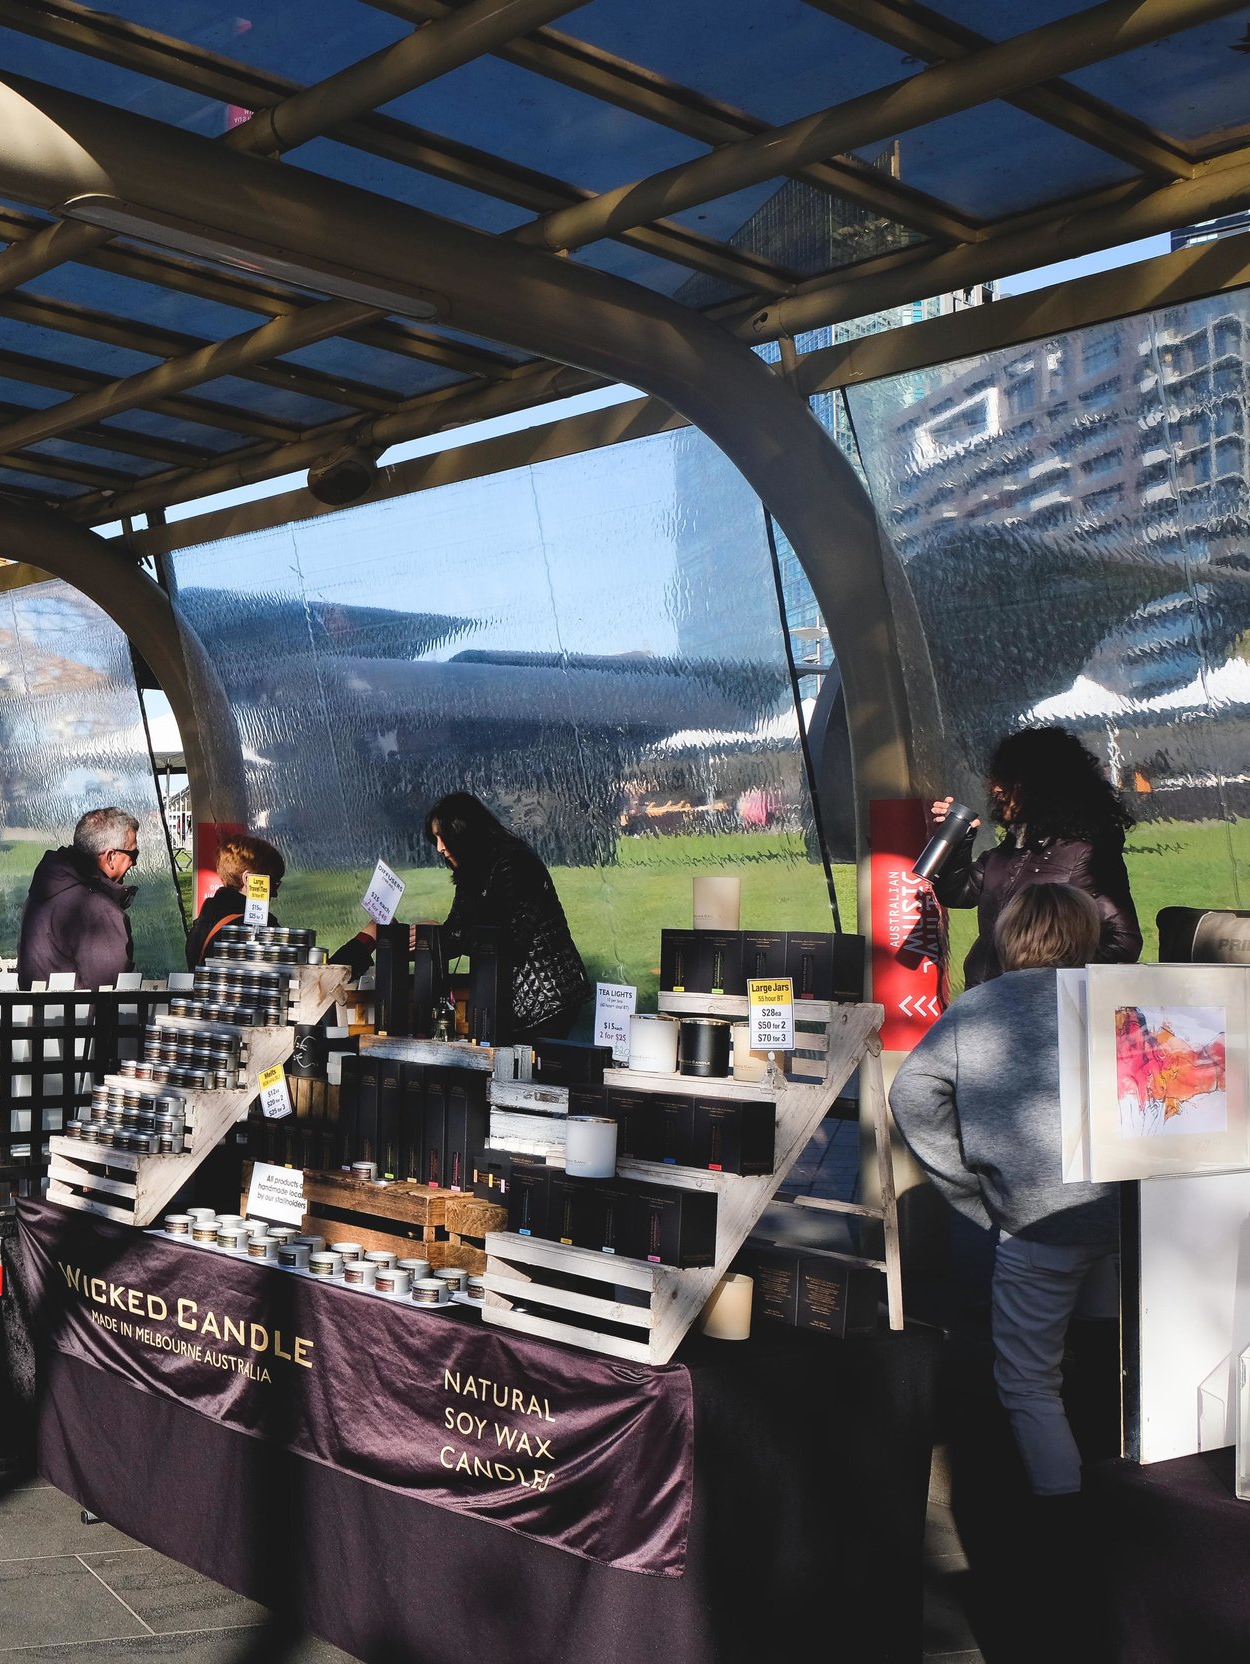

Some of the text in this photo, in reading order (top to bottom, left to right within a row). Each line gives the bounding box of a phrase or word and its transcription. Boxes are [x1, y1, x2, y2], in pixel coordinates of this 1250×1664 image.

[378, 865, 404, 892] DIFFUSERS
[380, 901, 390, 914] each
[888, 871, 900, 948] AUSTRALIAN
[599, 988, 633, 999] TEA LIGHTS
[751, 983, 790, 994] Large Jars
[776, 994, 784, 1002] BT
[758, 1021, 771, 1030] $50
[781, 1021, 786, 1029] 2
[604, 1032, 614, 1040] for
[615, 1033, 627, 1041] $25
[758, 1033, 771, 1042] $70
[781, 1033, 786, 1042] 3
[264, 1069, 277, 1079] Melts
[267, 1098, 275, 1108] $20
[268, 1108, 278, 1117] $25
[274, 1177, 298, 1189] products
[257, 1182, 288, 1195] handmade
[289, 1189, 303, 1199] loca
[257, 1187, 306, 1210] by our stallholders
[58, 1261, 314, 1368] WICKED CANDLE
[91, 1309, 272, 1384] MADE IN MELBOURNE AUSTRALIA
[444, 1368, 555, 1423] NATURAL
[444, 1407, 555, 1460] SOY WAX
[440, 1445, 555, 1492] CANDLES
